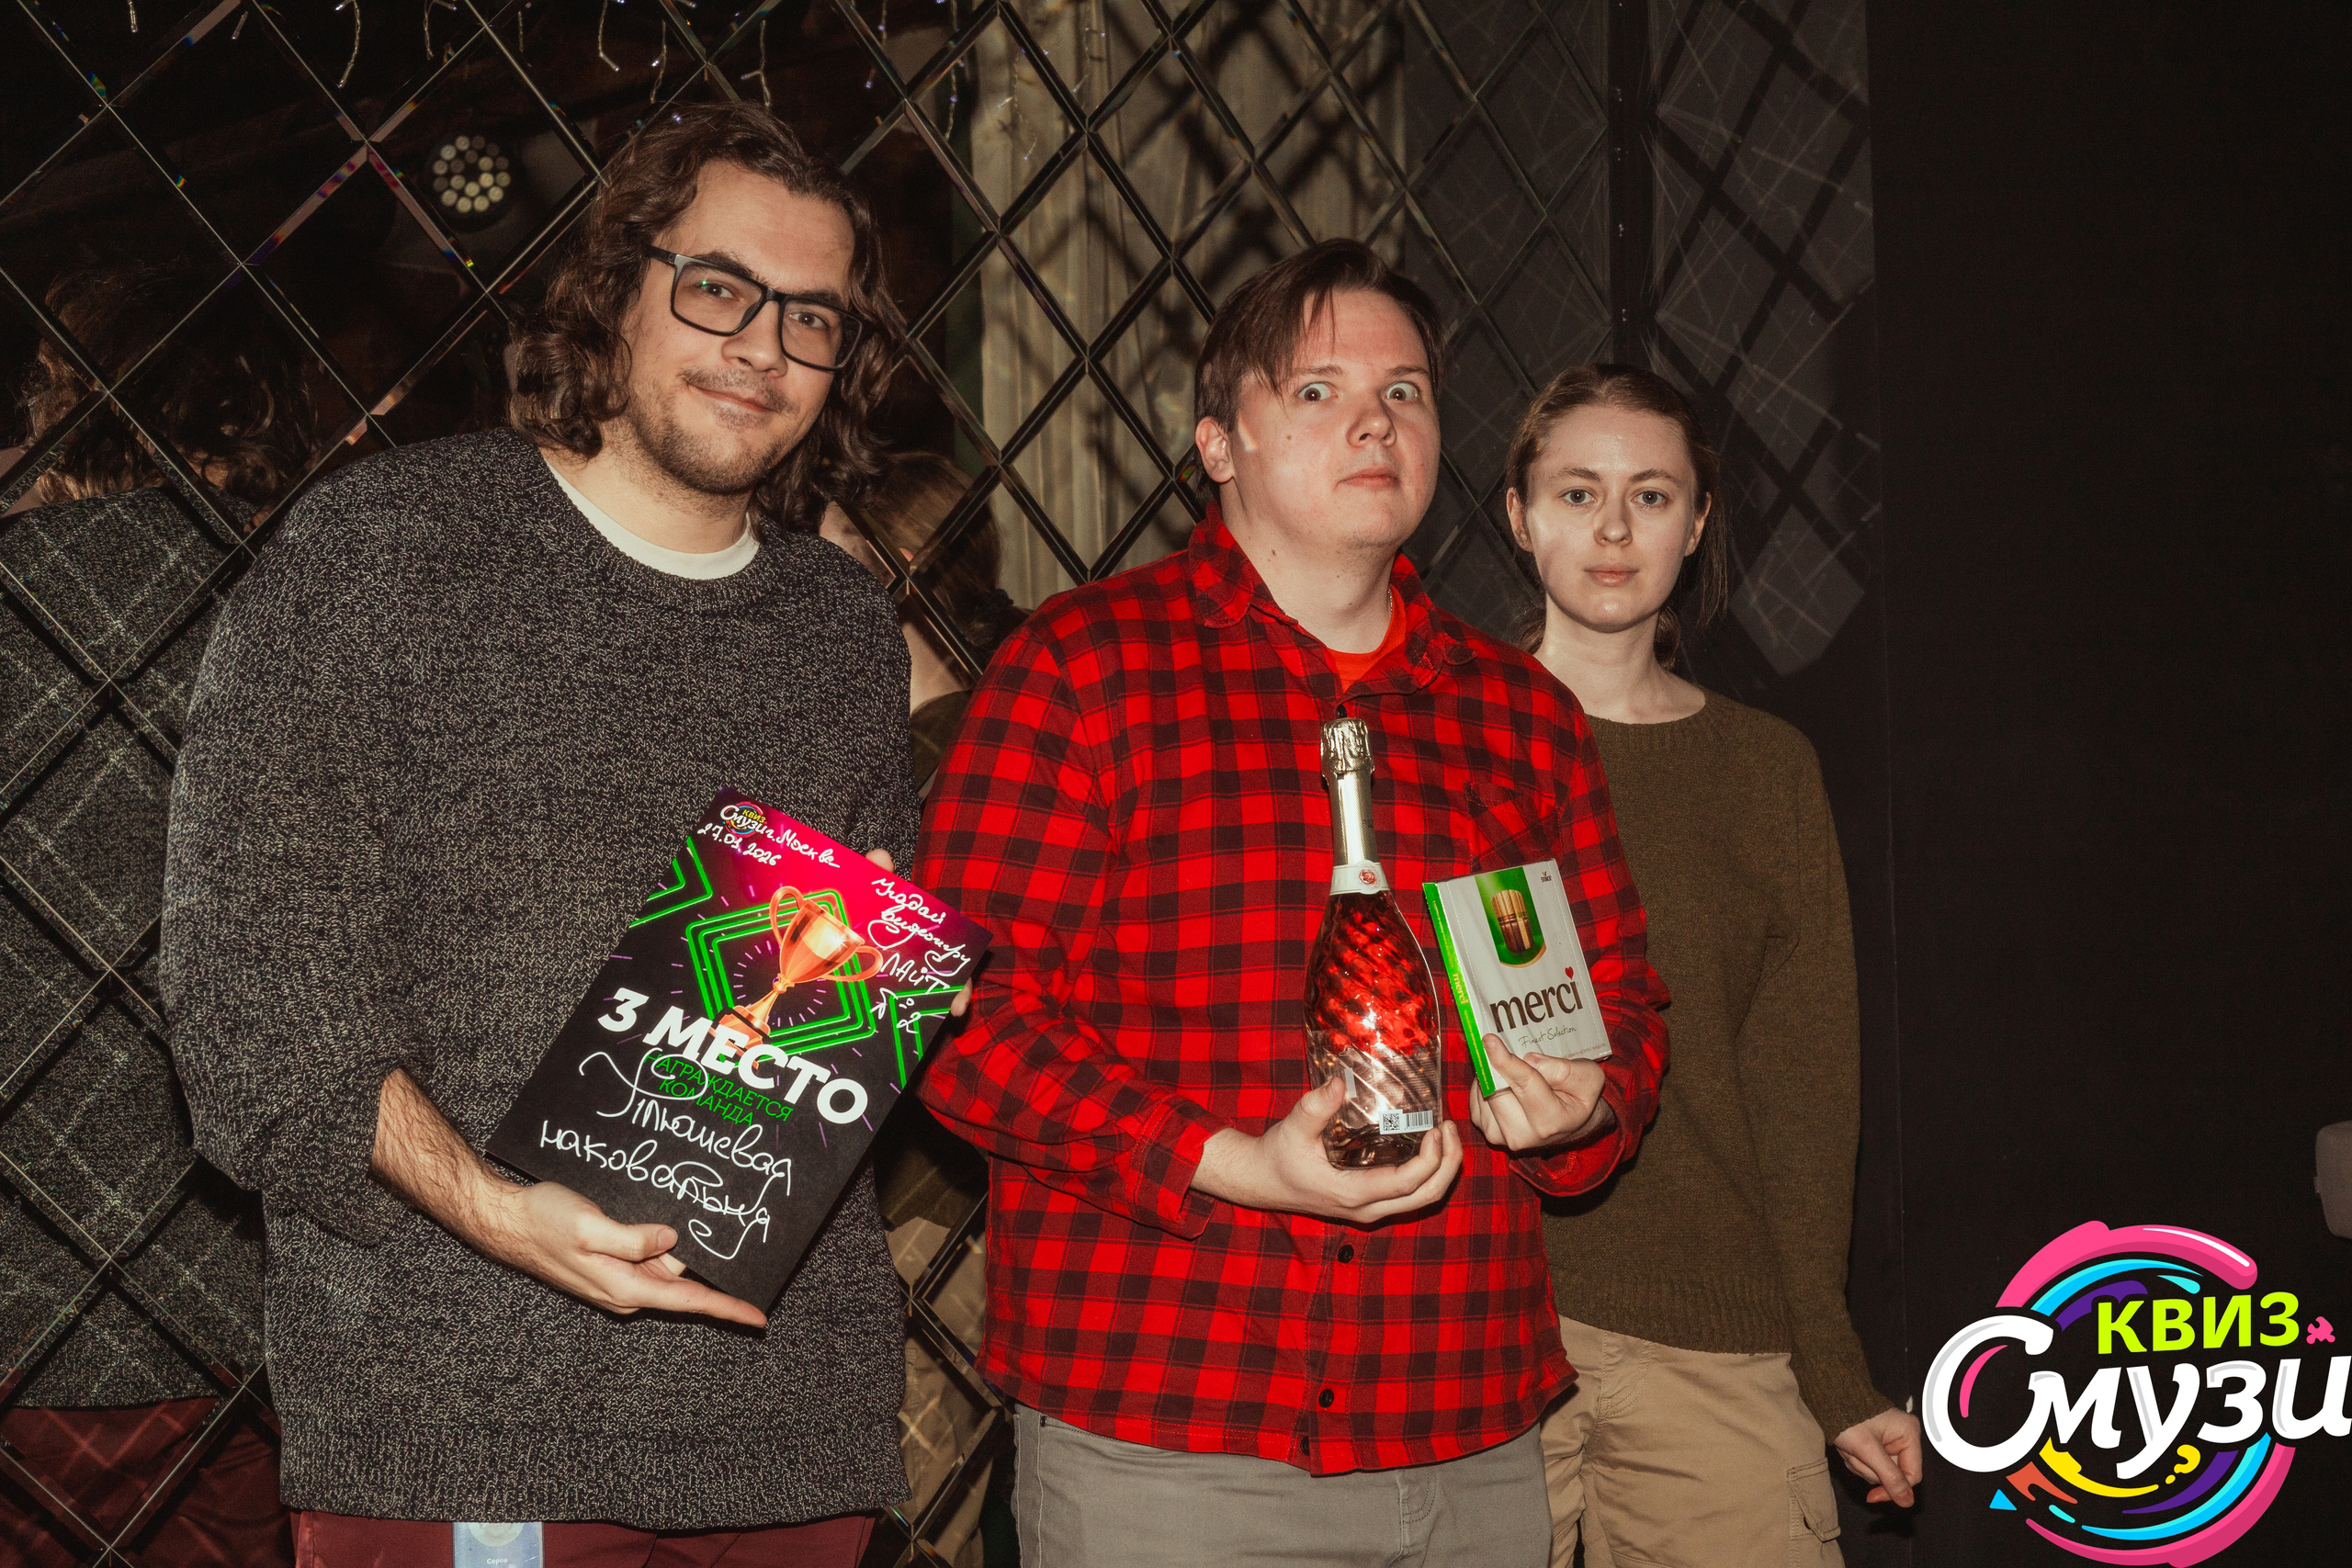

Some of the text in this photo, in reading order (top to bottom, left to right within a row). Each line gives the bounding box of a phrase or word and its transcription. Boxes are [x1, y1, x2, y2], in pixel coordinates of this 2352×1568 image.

[720, 805, 768, 835] Смузи
[742, 809, 766, 824] КВИЗ
[871, 877, 946, 924] Угадай
[880, 953, 951, 995] ЛАЙТ
[1453, 974, 1469, 1005] merci
[1489, 966, 1583, 1033] merci
[597, 987, 868, 1124] 3 МЕСТО
[1518, 1024, 1577, 1048] Finest Selection
[643, 1053, 794, 1122] НАГРАЖДАЕТСЯ
[659, 1078, 753, 1127] КОМАНДА
